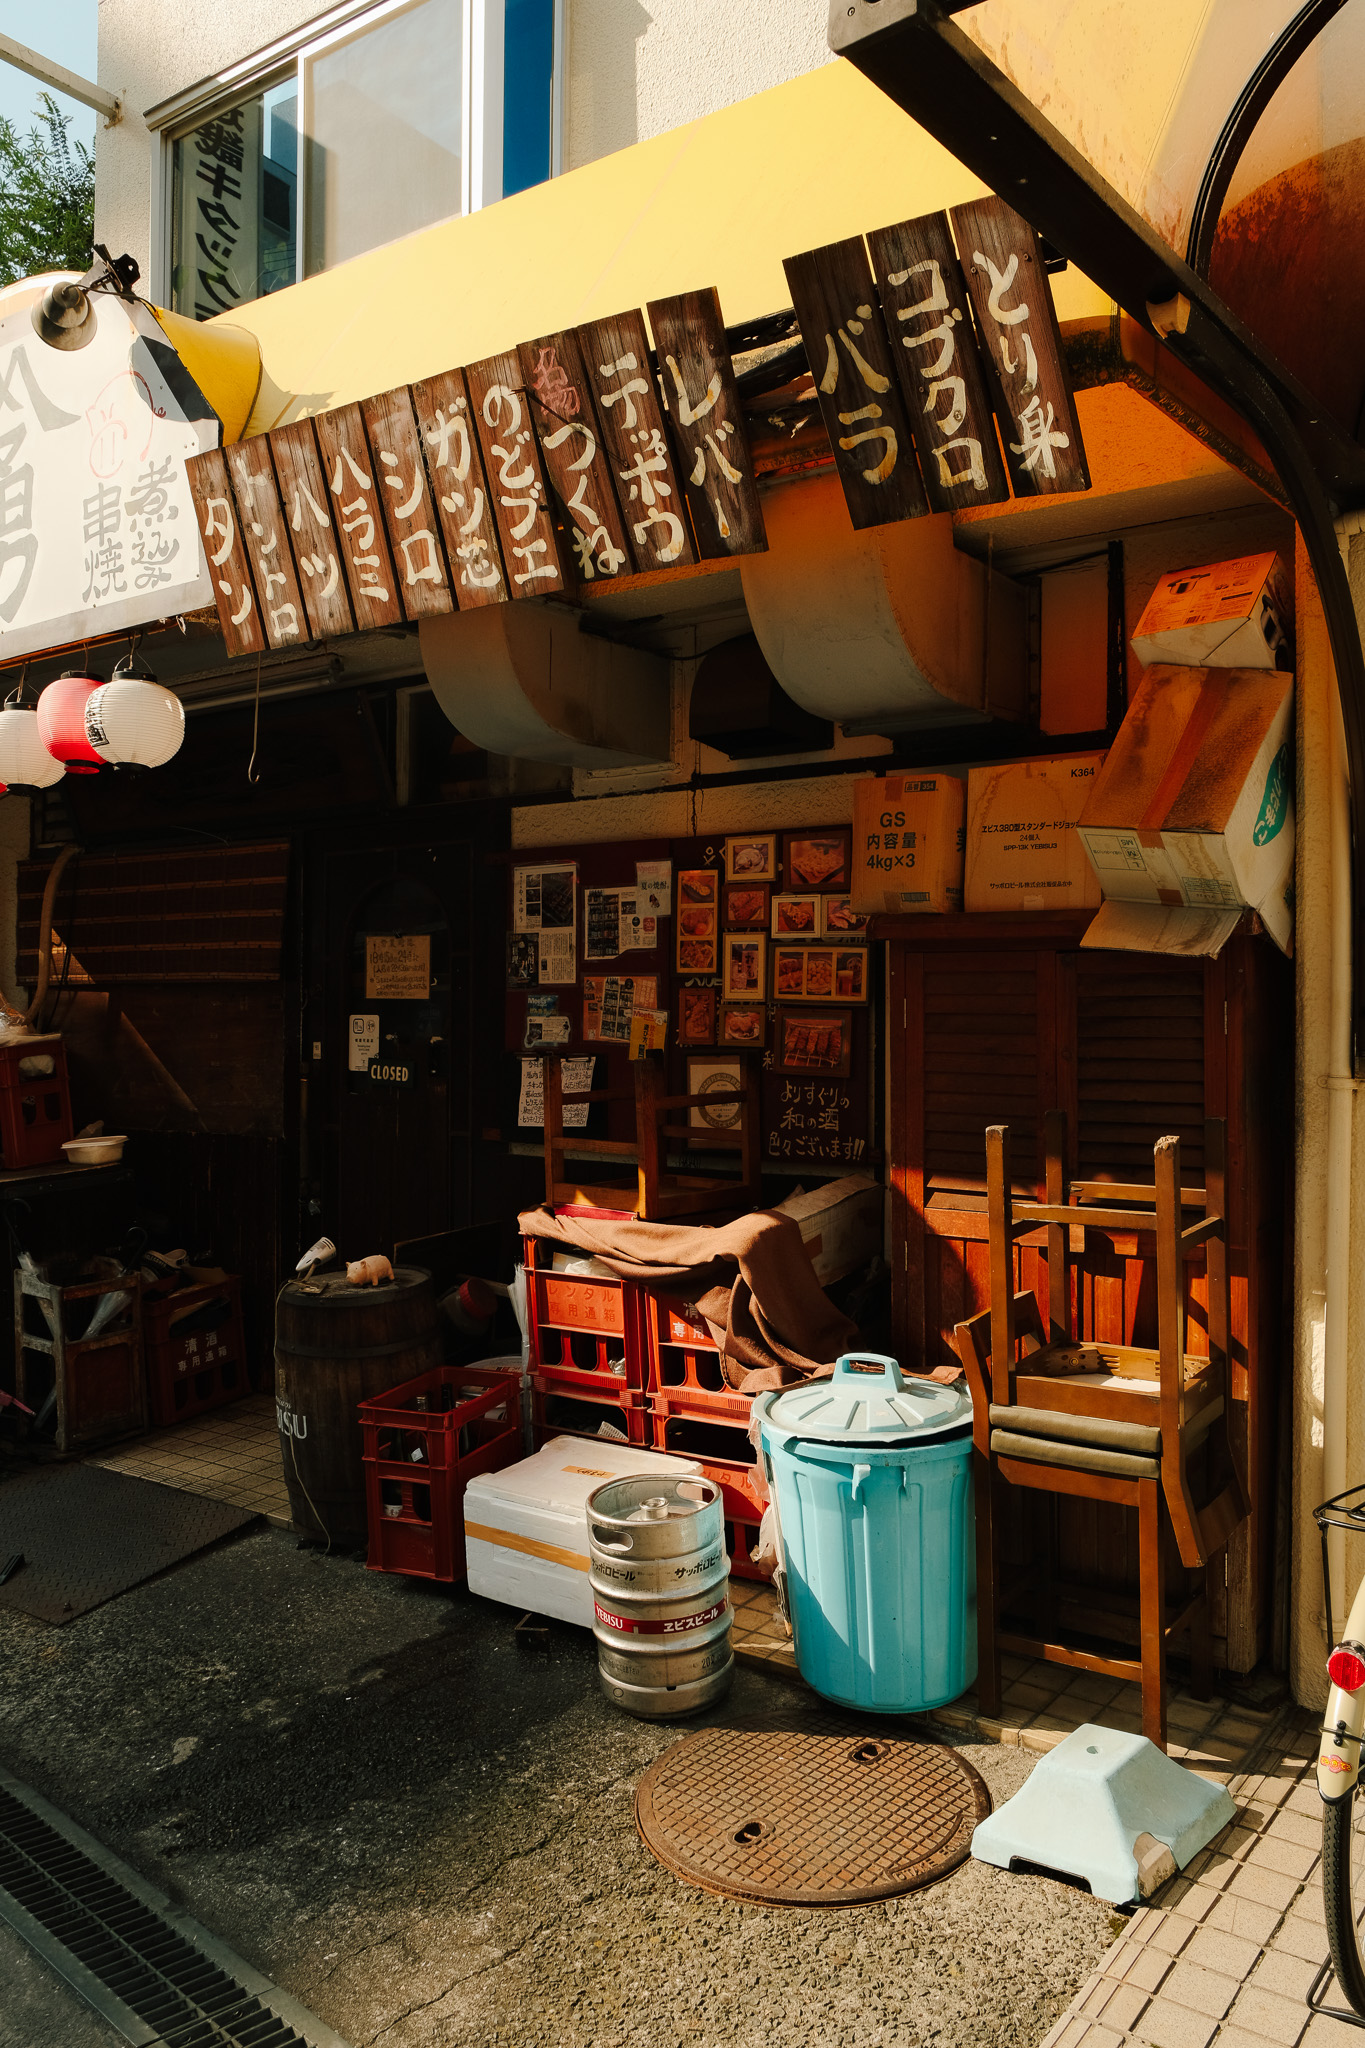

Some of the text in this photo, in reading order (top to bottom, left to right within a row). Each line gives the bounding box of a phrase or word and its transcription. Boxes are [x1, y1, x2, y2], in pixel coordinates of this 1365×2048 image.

[820, 304, 898, 485] バラ
[887, 259, 989, 491] コブクロ
[973, 250, 1070, 478] とり身
[543, 422, 625, 579] つくね
[665, 355, 743, 538] レバー
[82, 482, 128, 604] 串焼
[125, 455, 180, 588] 煮込み
[205, 497, 251, 625] タン
[236, 457, 299, 638] トントロ
[291, 478, 339, 599] ハツ
[331, 447, 389, 602] ハラミ
[880, 811, 906, 828] GS
[1071, 767, 1095, 778] K364
[867, 832, 917, 850] 内容量
[370, 1064, 409, 1082] CLOSED
[780, 1080, 850, 1108] よりすぐりの
[780, 1107, 839, 1131] 和の酒
[549, 1282, 614, 1303] レンタル
[596, 1604, 623, 1630] YEBISU
